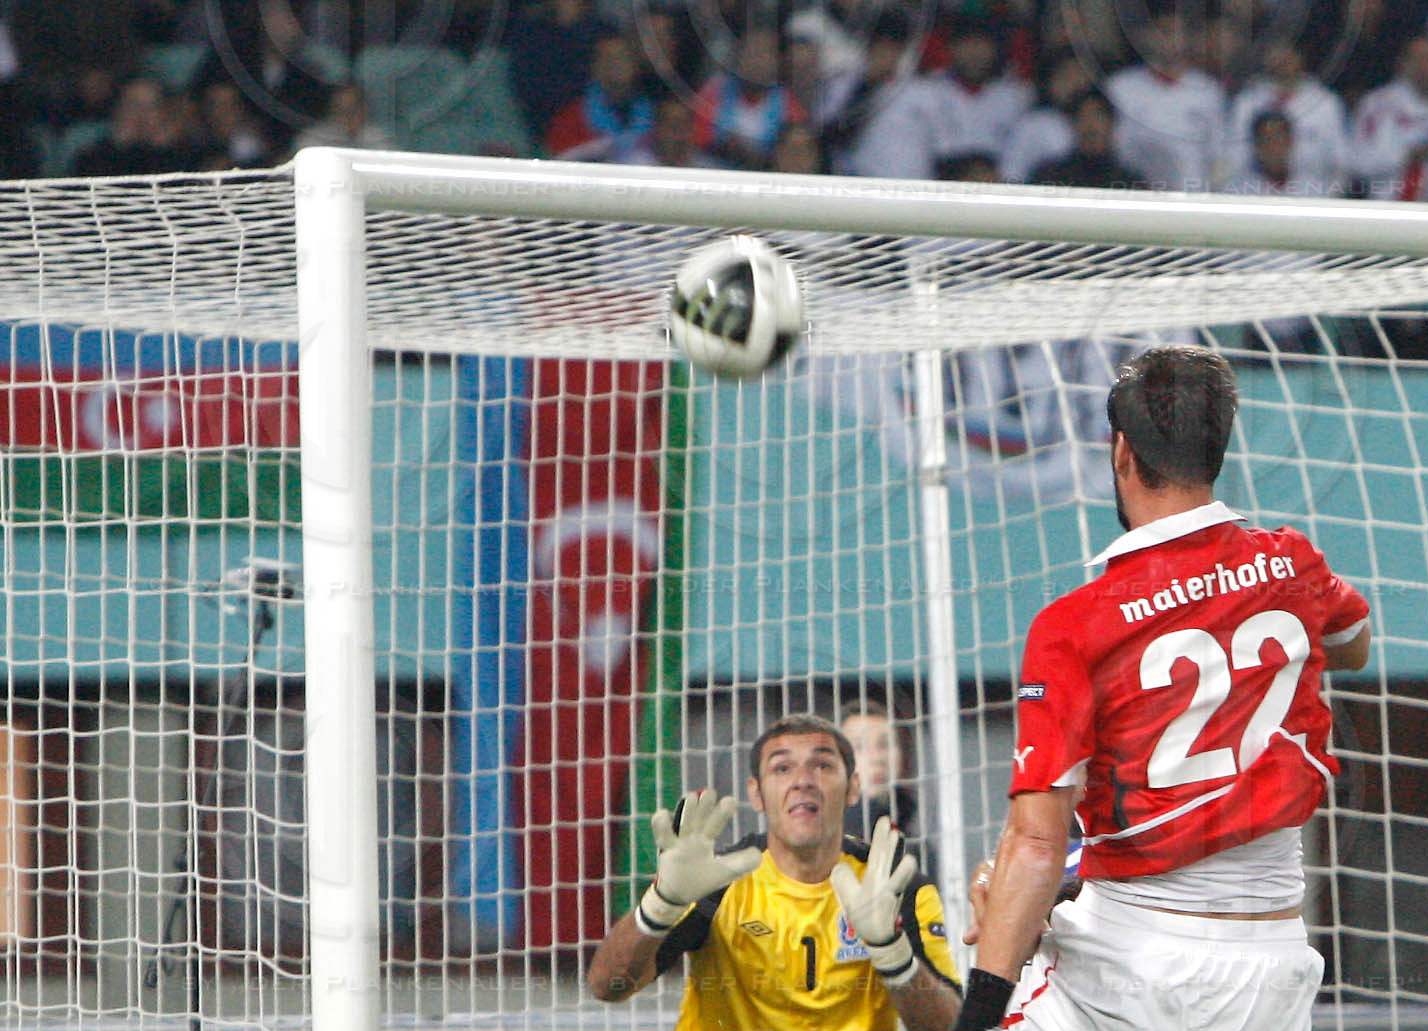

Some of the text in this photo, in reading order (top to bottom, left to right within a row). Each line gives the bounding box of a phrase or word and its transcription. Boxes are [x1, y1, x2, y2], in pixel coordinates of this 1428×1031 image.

[1119, 553, 1297, 624] maierhofer
[1139, 609, 1311, 789] 22
[800, 935, 817, 992] 1
